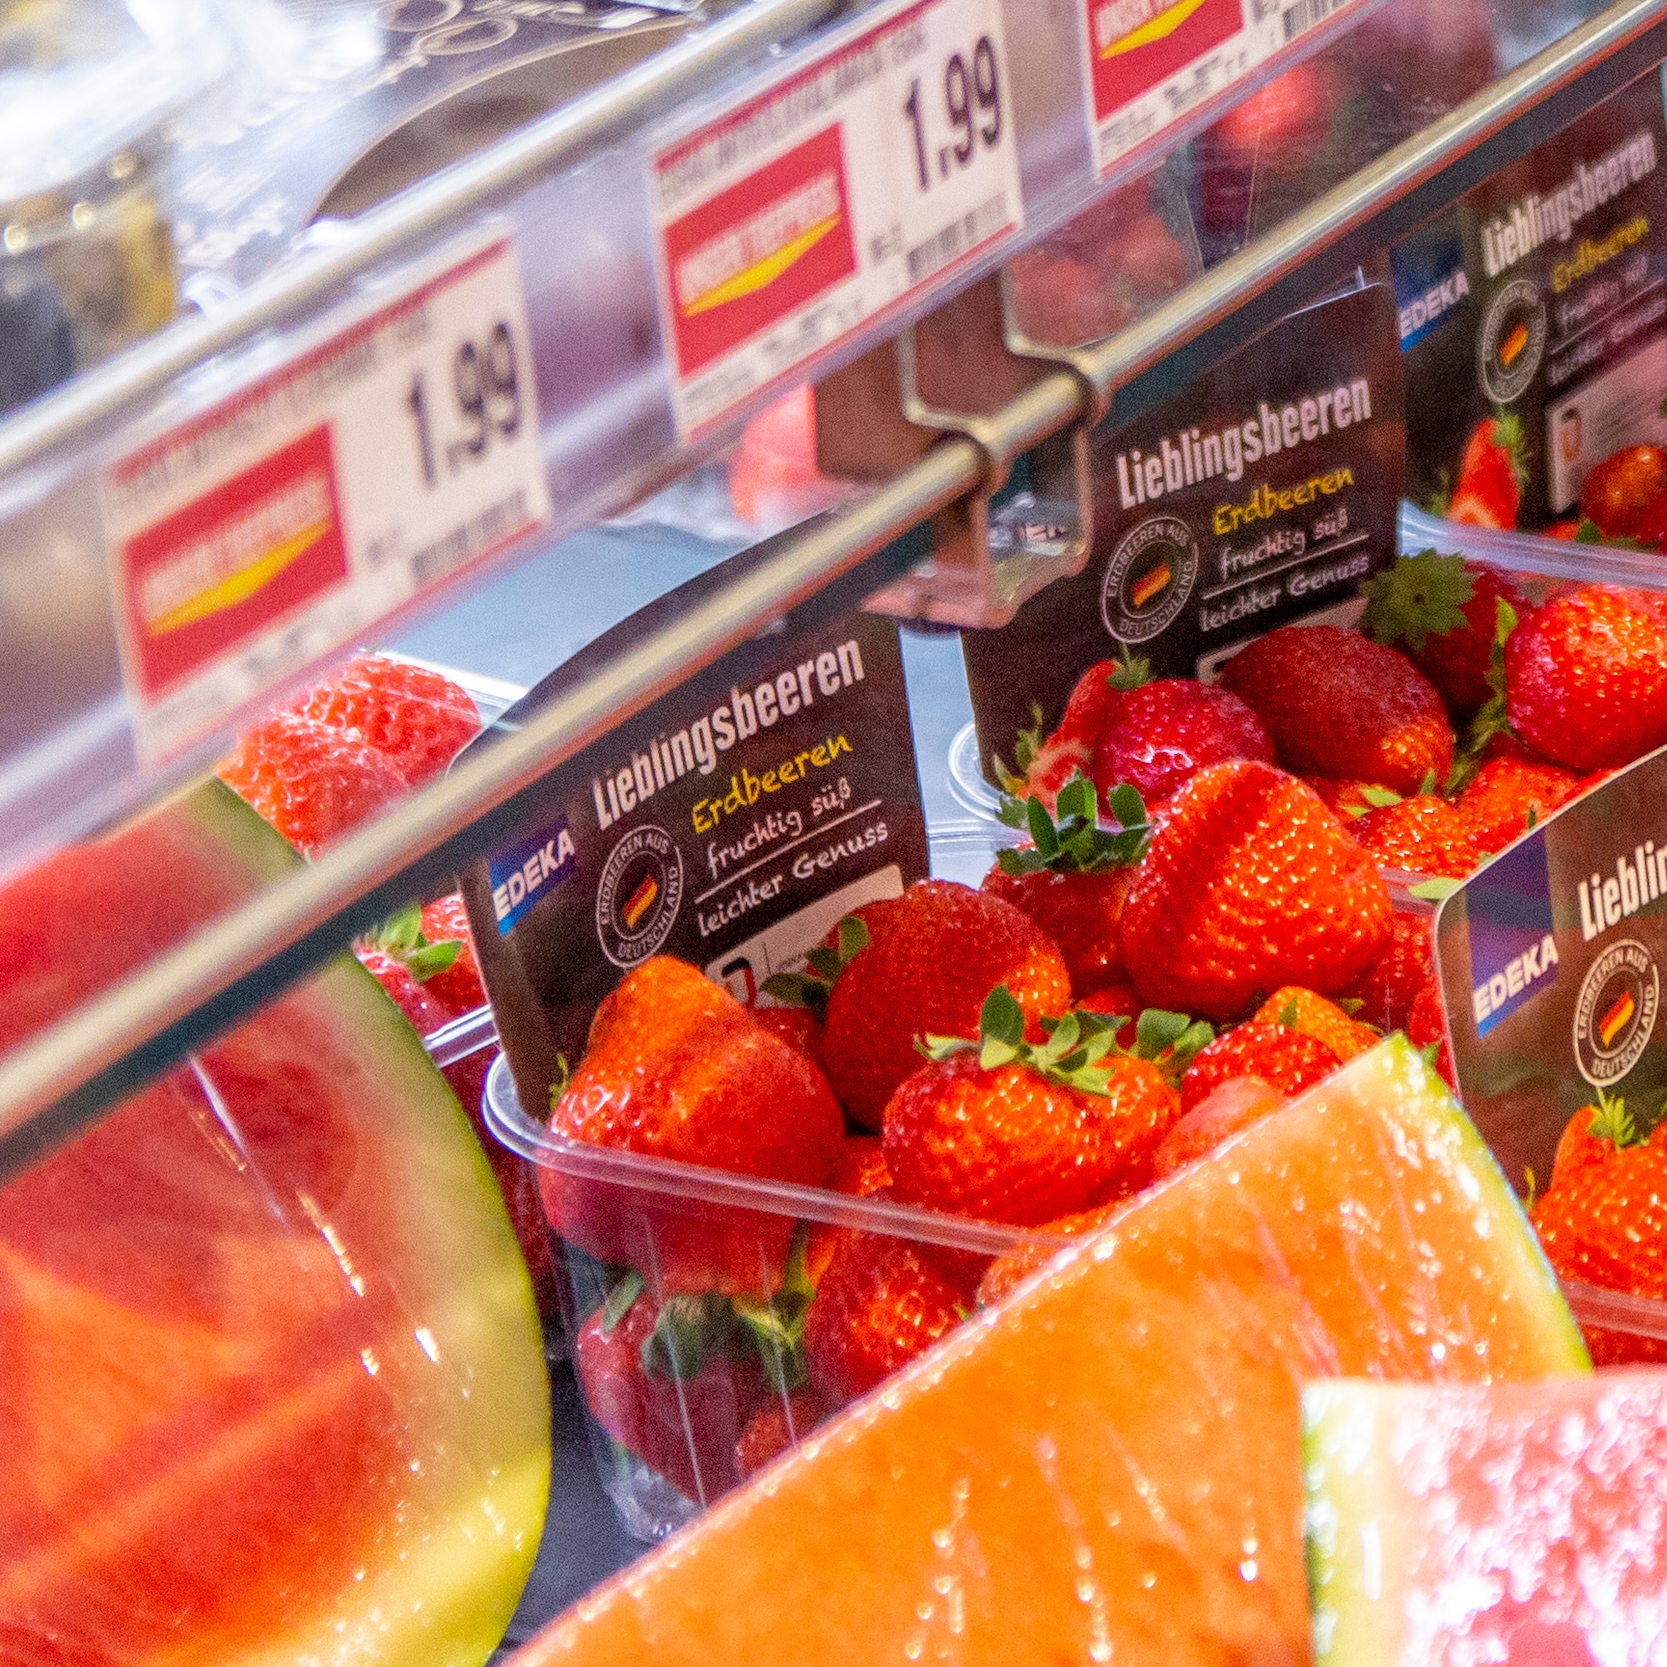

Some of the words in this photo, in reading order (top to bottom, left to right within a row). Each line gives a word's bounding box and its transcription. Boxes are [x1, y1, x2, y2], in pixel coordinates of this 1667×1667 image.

[903, 30, 1003, 200] 1.99
[1481, 133, 1658, 279] Lieblingsbeeren
[1400, 270, 1469, 338] EDEKA
[404, 316, 524, 499] 1.99
[1116, 377, 1373, 510] Lieblingsbeeren
[1213, 465, 1354, 535] Erdbeeren
[1219, 529, 1306, 581] fruchtig
[1313, 507, 1349, 538] süß
[1202, 584, 1281, 632] leichter
[1287, 553, 1370, 597] Genuss
[591, 638, 865, 831] Lieblingsbeeren
[690, 734, 852, 834] Erdbeeren
[706, 806, 805, 881] fruchtig
[811, 779, 852, 813] süß
[493, 828, 576, 920] EDEKA
[616, 865, 682, 959] DEUTSCHLAND
[696, 875, 786, 938] leichter
[791, 821, 889, 880] Genuss
[1473, 934, 1560, 1022] EDEKA
[1591, 984, 1656, 1079] DEUTSCHLAND
